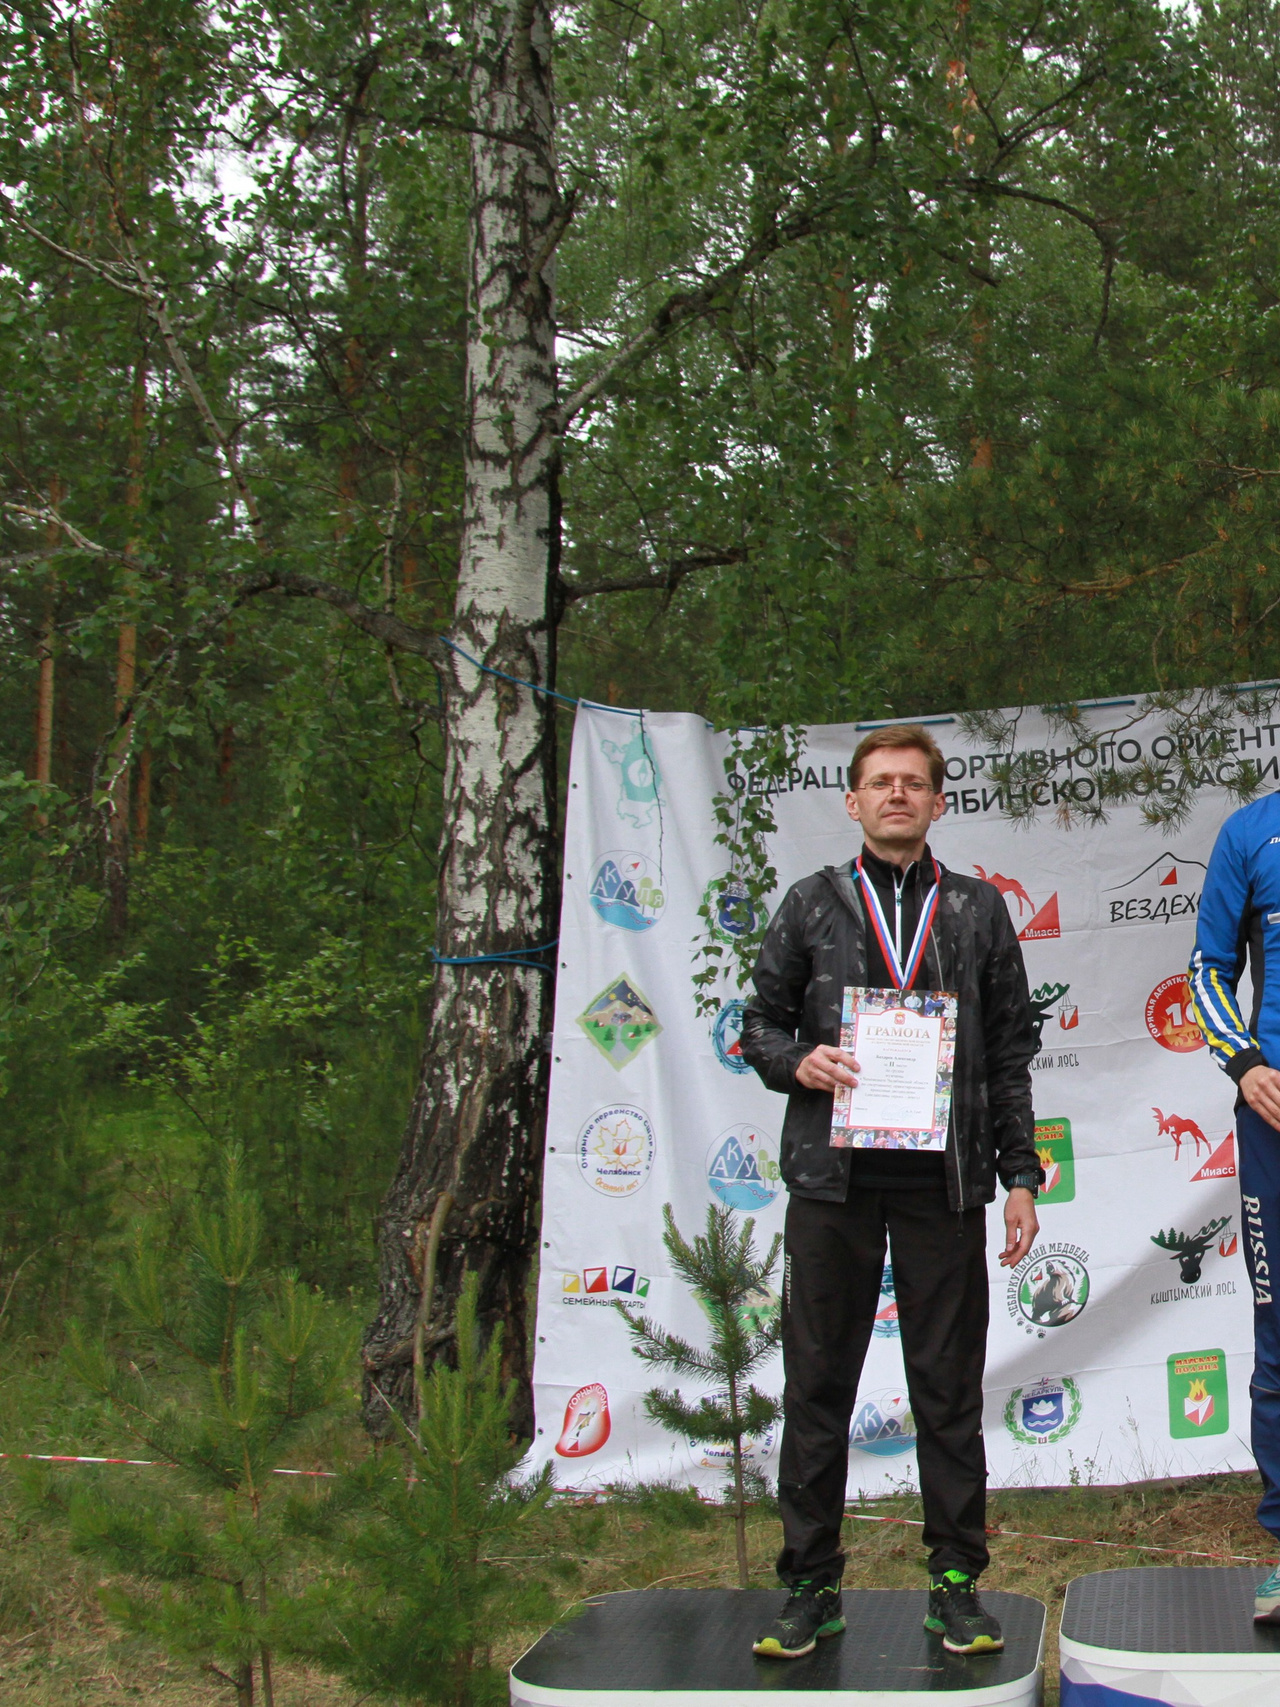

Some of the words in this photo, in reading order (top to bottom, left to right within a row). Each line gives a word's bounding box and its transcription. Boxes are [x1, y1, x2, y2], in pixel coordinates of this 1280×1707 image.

[727, 765, 851, 797] ФЕДЕРАЦ
[944, 739, 1142, 782] ОРТИВНОГО
[944, 767, 1118, 815] ЯБИНСКО
[1109, 891, 1202, 925] ВЕЗДЕХ
[1024, 928, 1060, 938] Миасс
[1153, 975, 1189, 999] ДЕСЯТКА
[1147, 998, 1161, 1038] ГОРЯЧАЯ
[866, 1025, 931, 1039] ГРАМОТА
[1057, 1053, 1080, 1068] ЛОСЬ
[581, 1124, 595, 1169] Открытое
[594, 1108, 644, 1124] первенство
[1035, 1131, 1065, 1141] ЛЯНА
[596, 1167, 642, 1176] Челябинск
[1200, 1166, 1235, 1178] Миасс
[1242, 1193, 1273, 1306] RUSSIA
[1006, 1243, 1047, 1318] ЧЕБАРКУЛЬСКИЙ
[1048, 1242, 1091, 1264] МЕДВЕДЬ
[1150, 1282, 1213, 1305] КЫШТЫМСКИЙ
[1215, 1281, 1237, 1297] ЛОСЬ
[562, 1296, 616, 1308] СЕМЕЙНЫЕ
[888, 1310, 899, 1318] 20
[1175, 1355, 1219, 1367] МАЙСКАЯ
[1175, 1363, 1219, 1375] ПОЛЯНА
